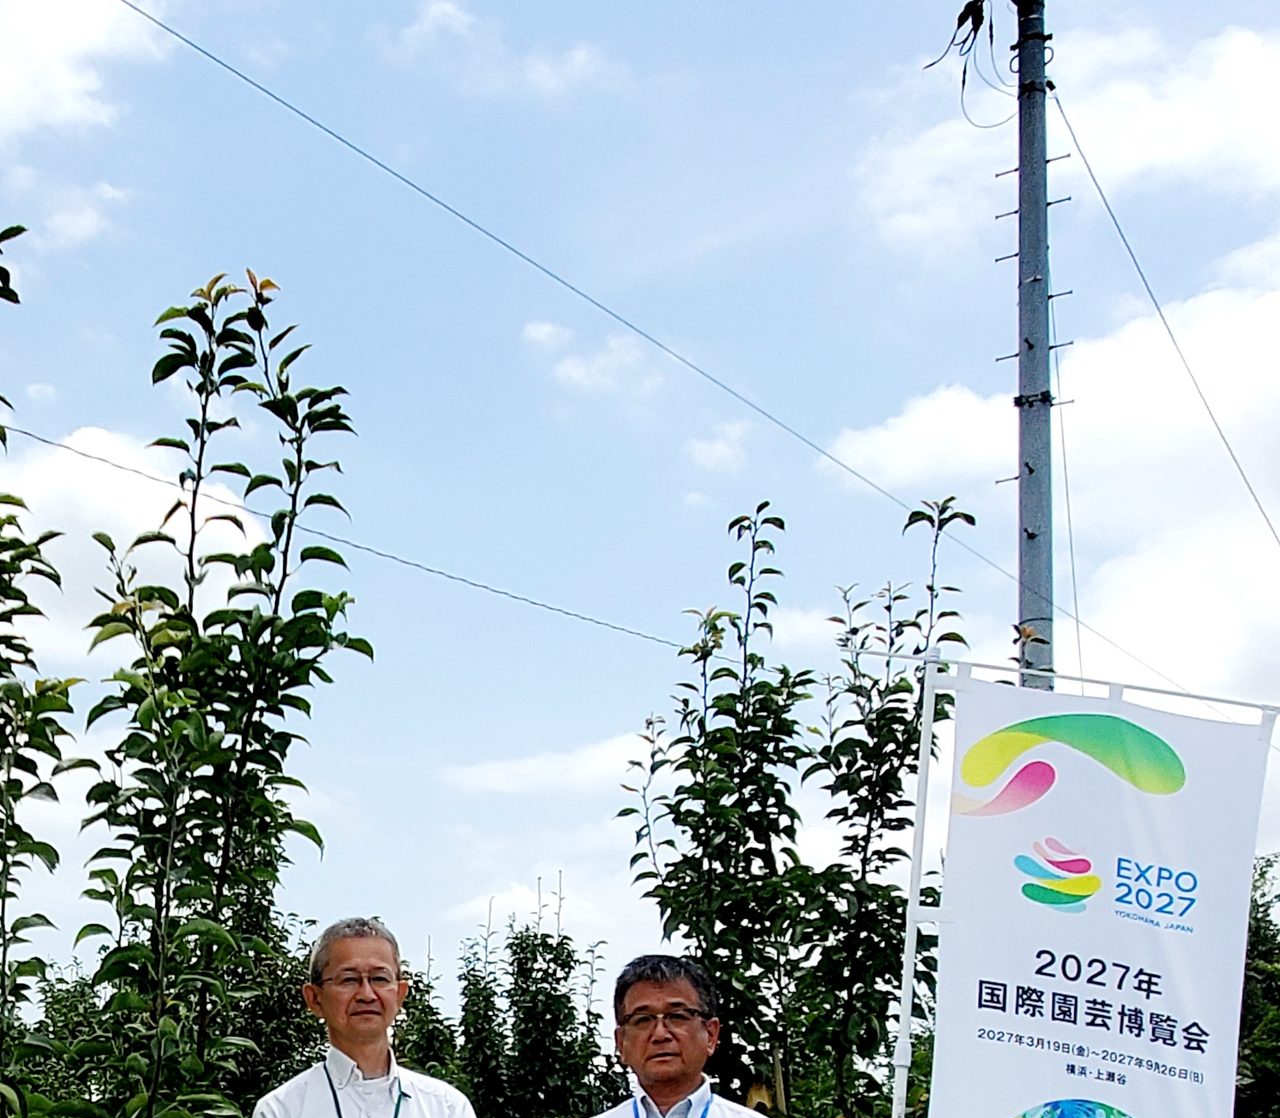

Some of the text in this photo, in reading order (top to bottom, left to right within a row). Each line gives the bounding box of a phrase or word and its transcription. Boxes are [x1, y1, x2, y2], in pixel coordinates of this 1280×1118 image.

[1115, 857, 1199, 894] EXPO
[1114, 882, 1197, 918] 2027
[1114, 910, 1195, 934] YOKOHAMA JAPAN
[1034, 948, 1163, 1000] 2027年
[976, 979, 1211, 1055] 国際園芸博覧会
